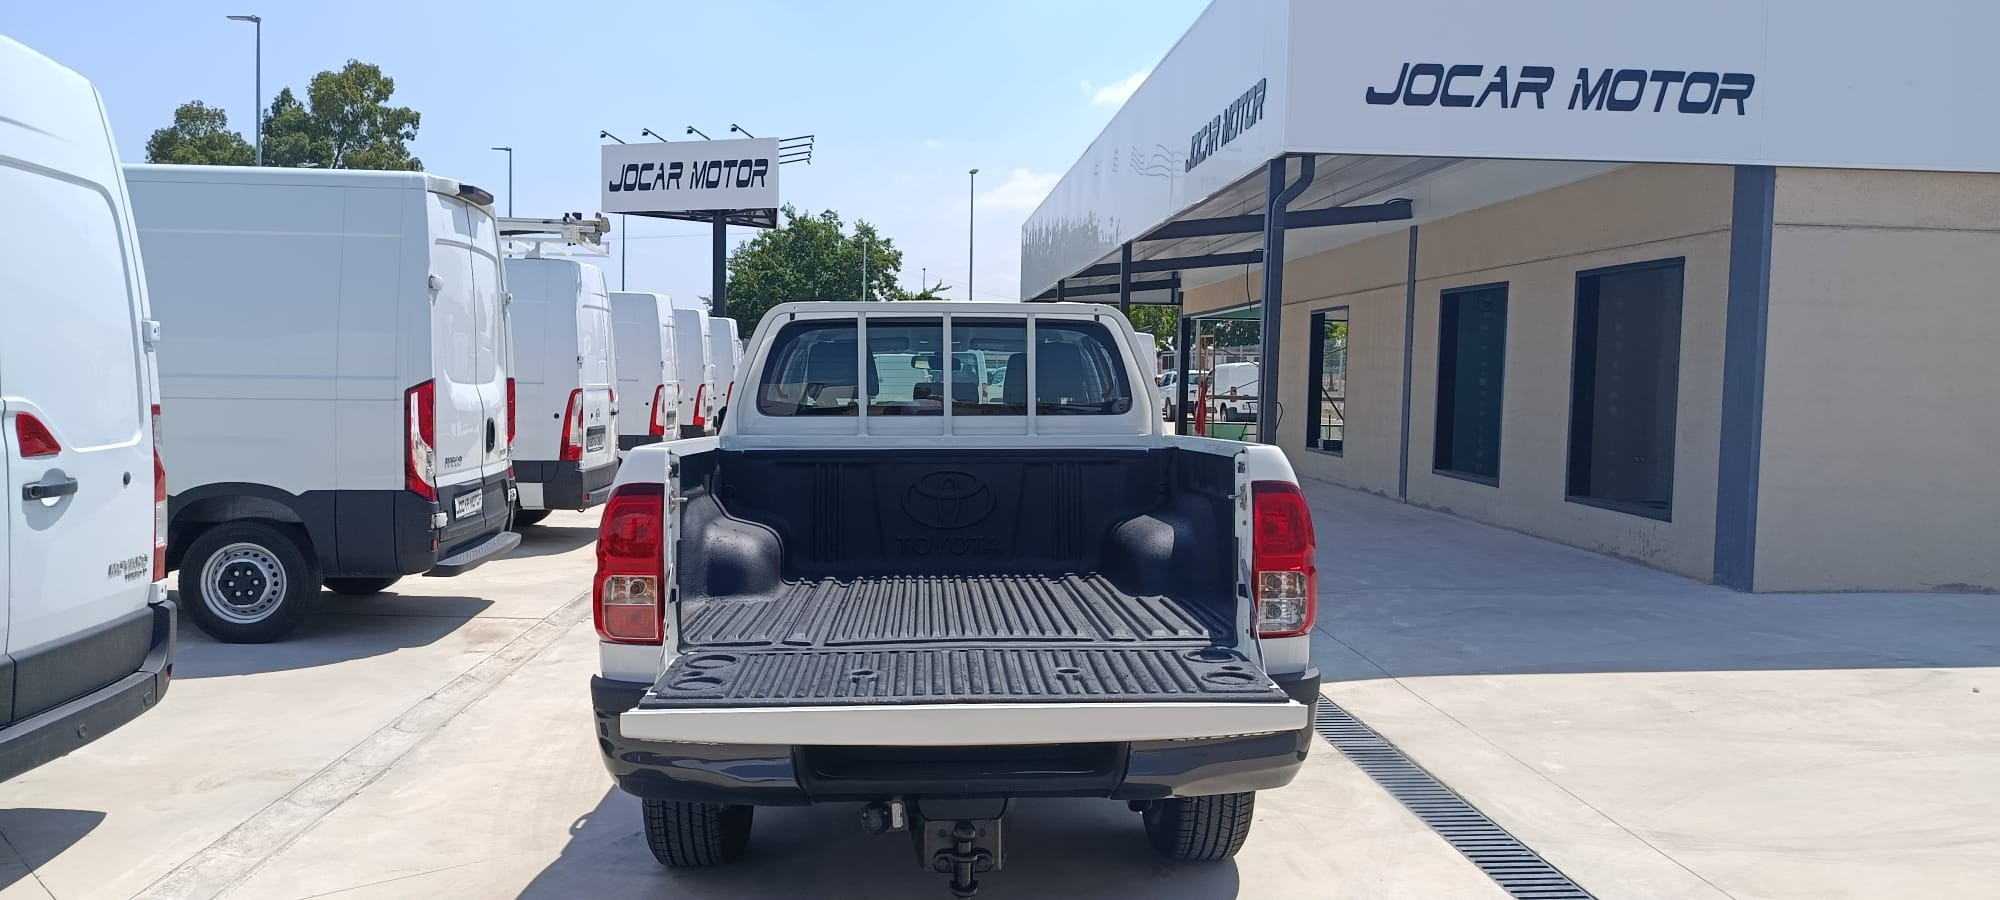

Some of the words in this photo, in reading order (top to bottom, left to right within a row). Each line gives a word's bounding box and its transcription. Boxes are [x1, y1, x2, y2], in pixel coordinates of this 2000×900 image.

[1366, 63, 1555, 110] JOCAR
[1568, 67, 1756, 116] MOTOR
[1185, 114, 1221, 173] JOCAR
[1221, 77, 1267, 147] MOTOR
[608, 161, 684, 192] JOCAR
[689, 158, 769, 189] MOTOR
[895, 535, 1003, 556] TOYOTA
